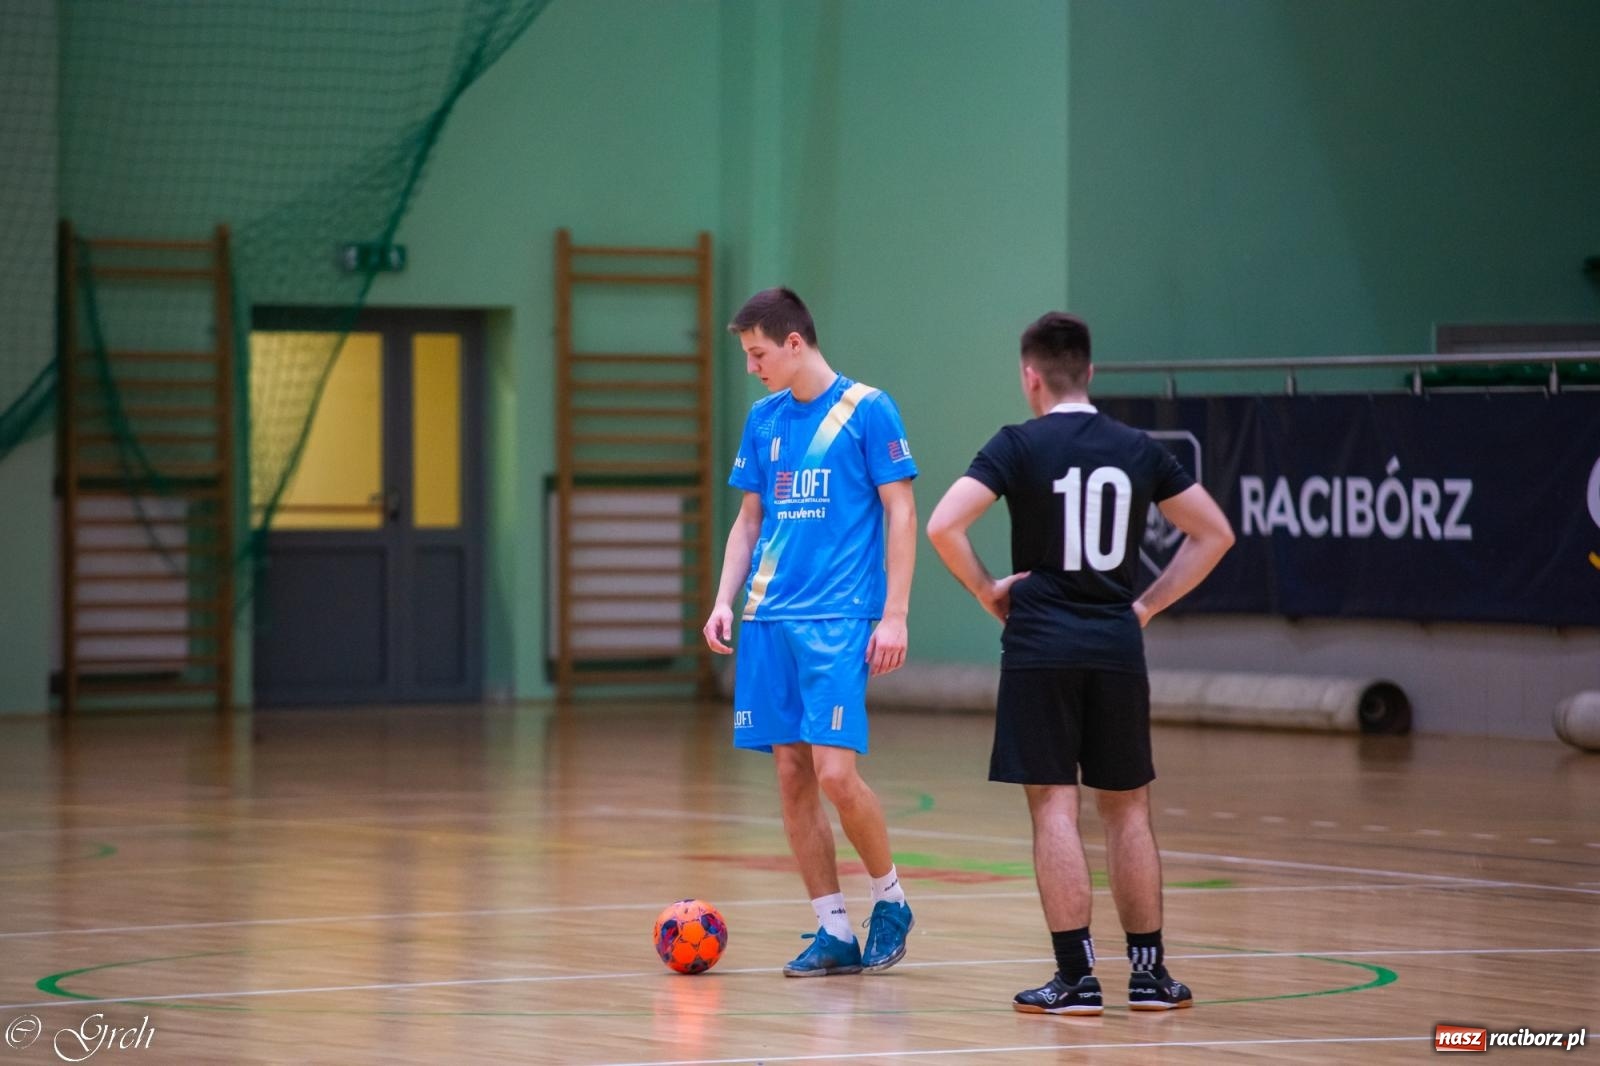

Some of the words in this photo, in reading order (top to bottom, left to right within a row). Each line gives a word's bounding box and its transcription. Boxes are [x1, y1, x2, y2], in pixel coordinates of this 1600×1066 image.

[792, 469, 832, 498] LOFT
[1053, 466, 1132, 571] 10
[1240, 455, 1473, 541] RACIBÓRZ
